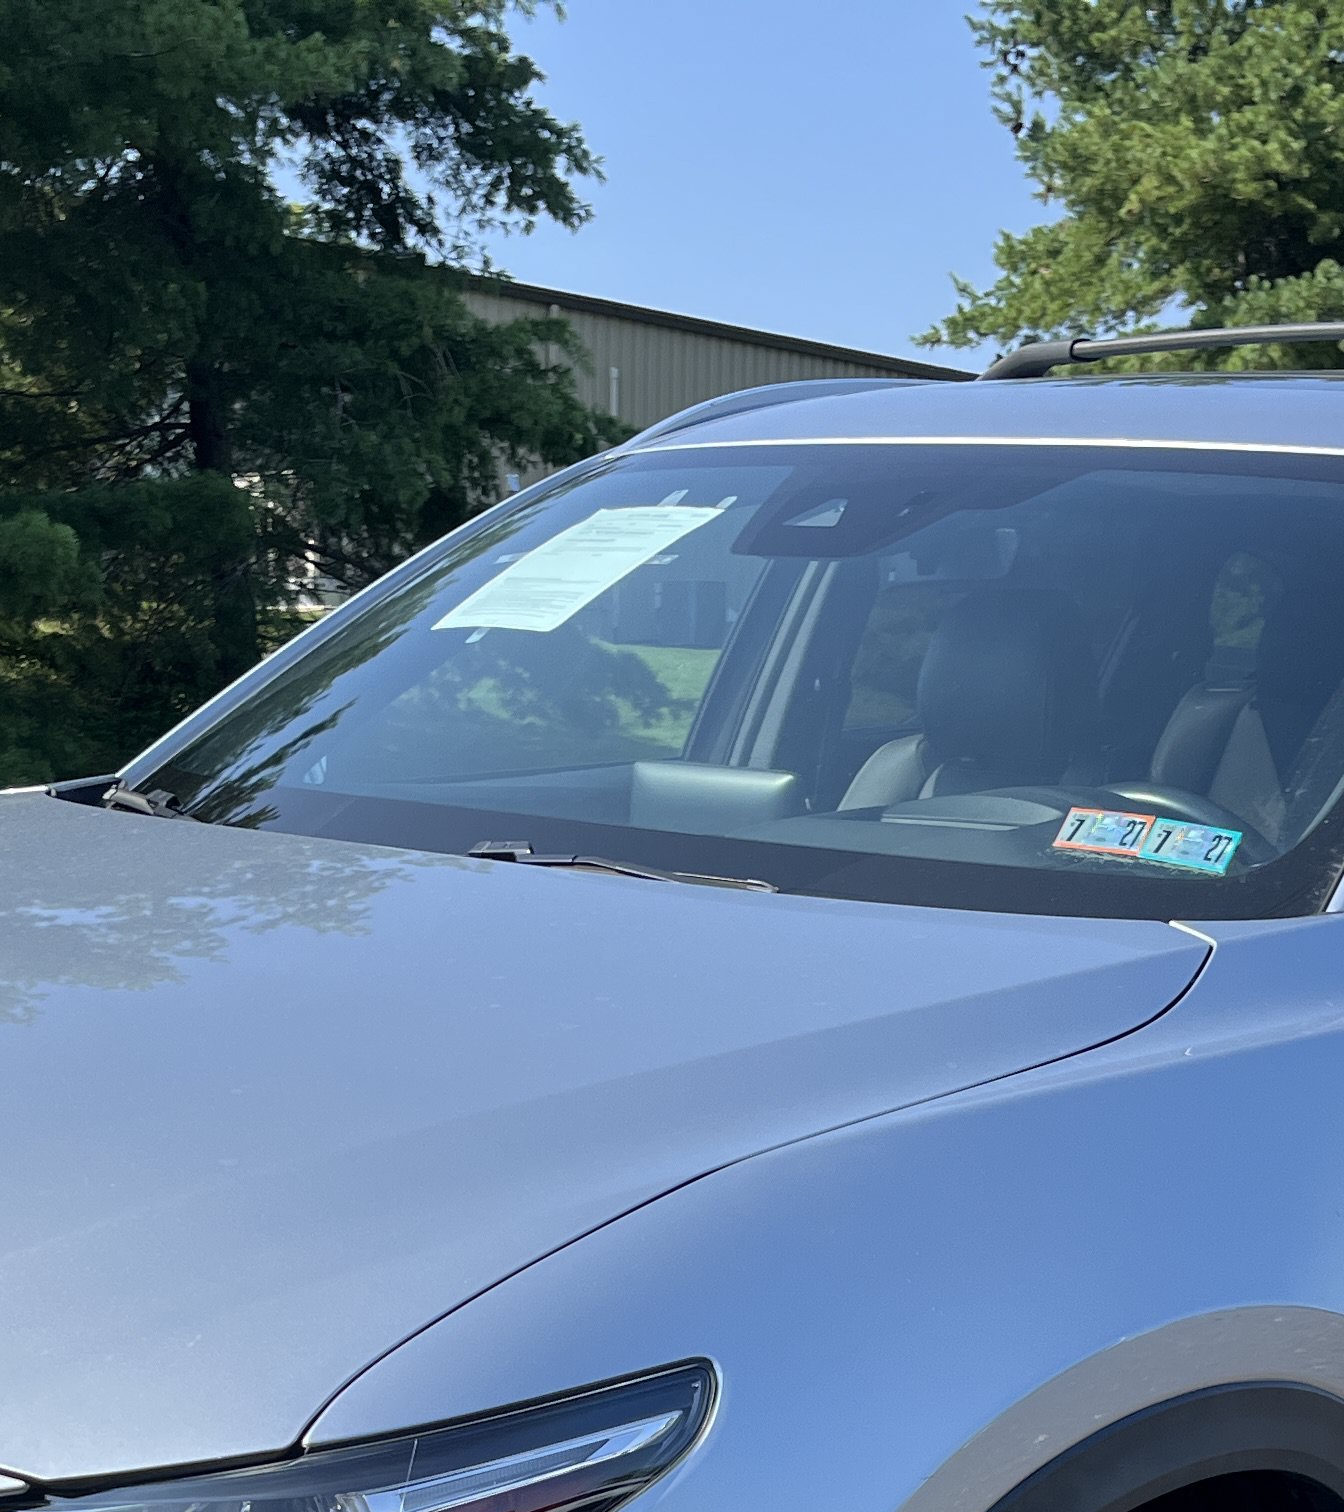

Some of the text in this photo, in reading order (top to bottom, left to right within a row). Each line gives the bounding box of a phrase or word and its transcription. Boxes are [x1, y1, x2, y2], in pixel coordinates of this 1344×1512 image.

[1066, 818, 1147, 849] 7 27
[1152, 829, 1233, 864] 7 27
